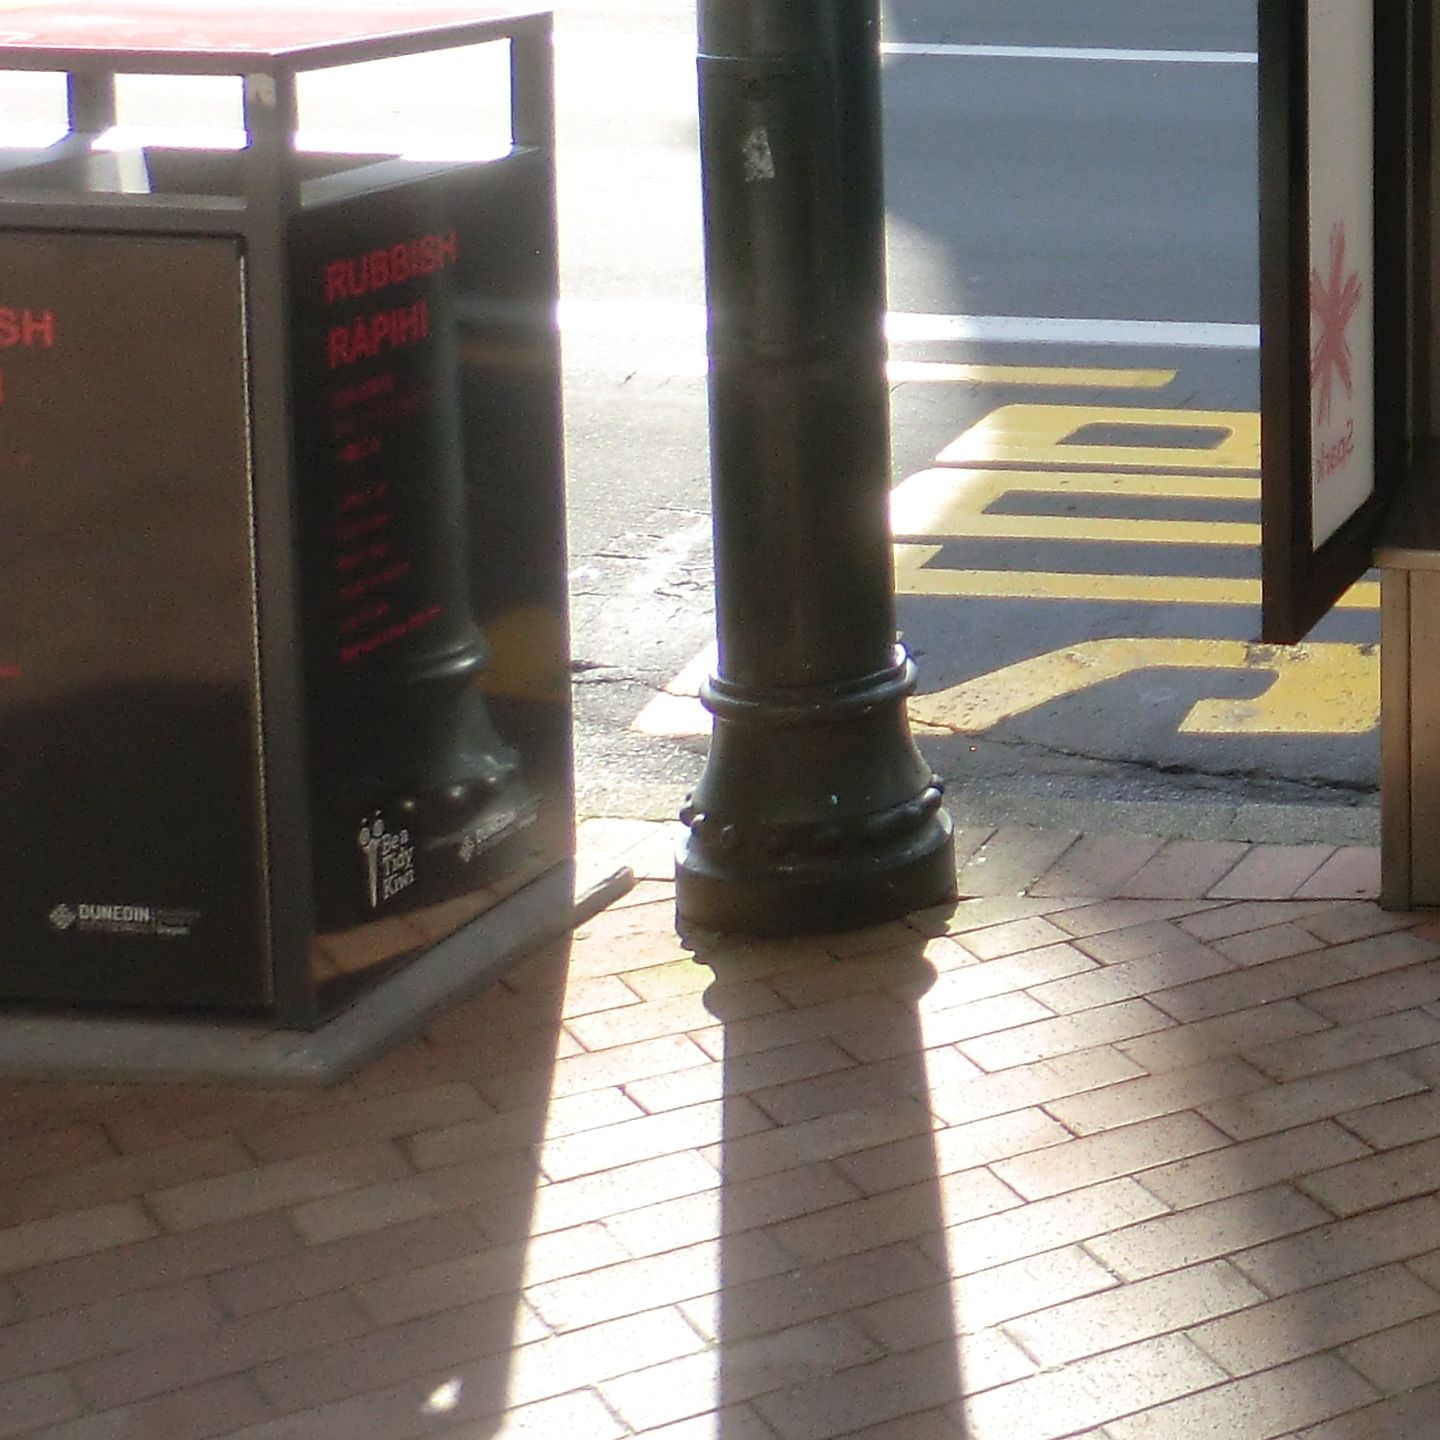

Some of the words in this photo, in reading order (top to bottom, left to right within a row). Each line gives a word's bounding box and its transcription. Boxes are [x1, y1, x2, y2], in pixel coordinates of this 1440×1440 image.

[324, 228, 458, 304] RUBBISH
[383, 869, 416, 900] Kiwi
[78, 903, 151, 922] DUNEDIN
